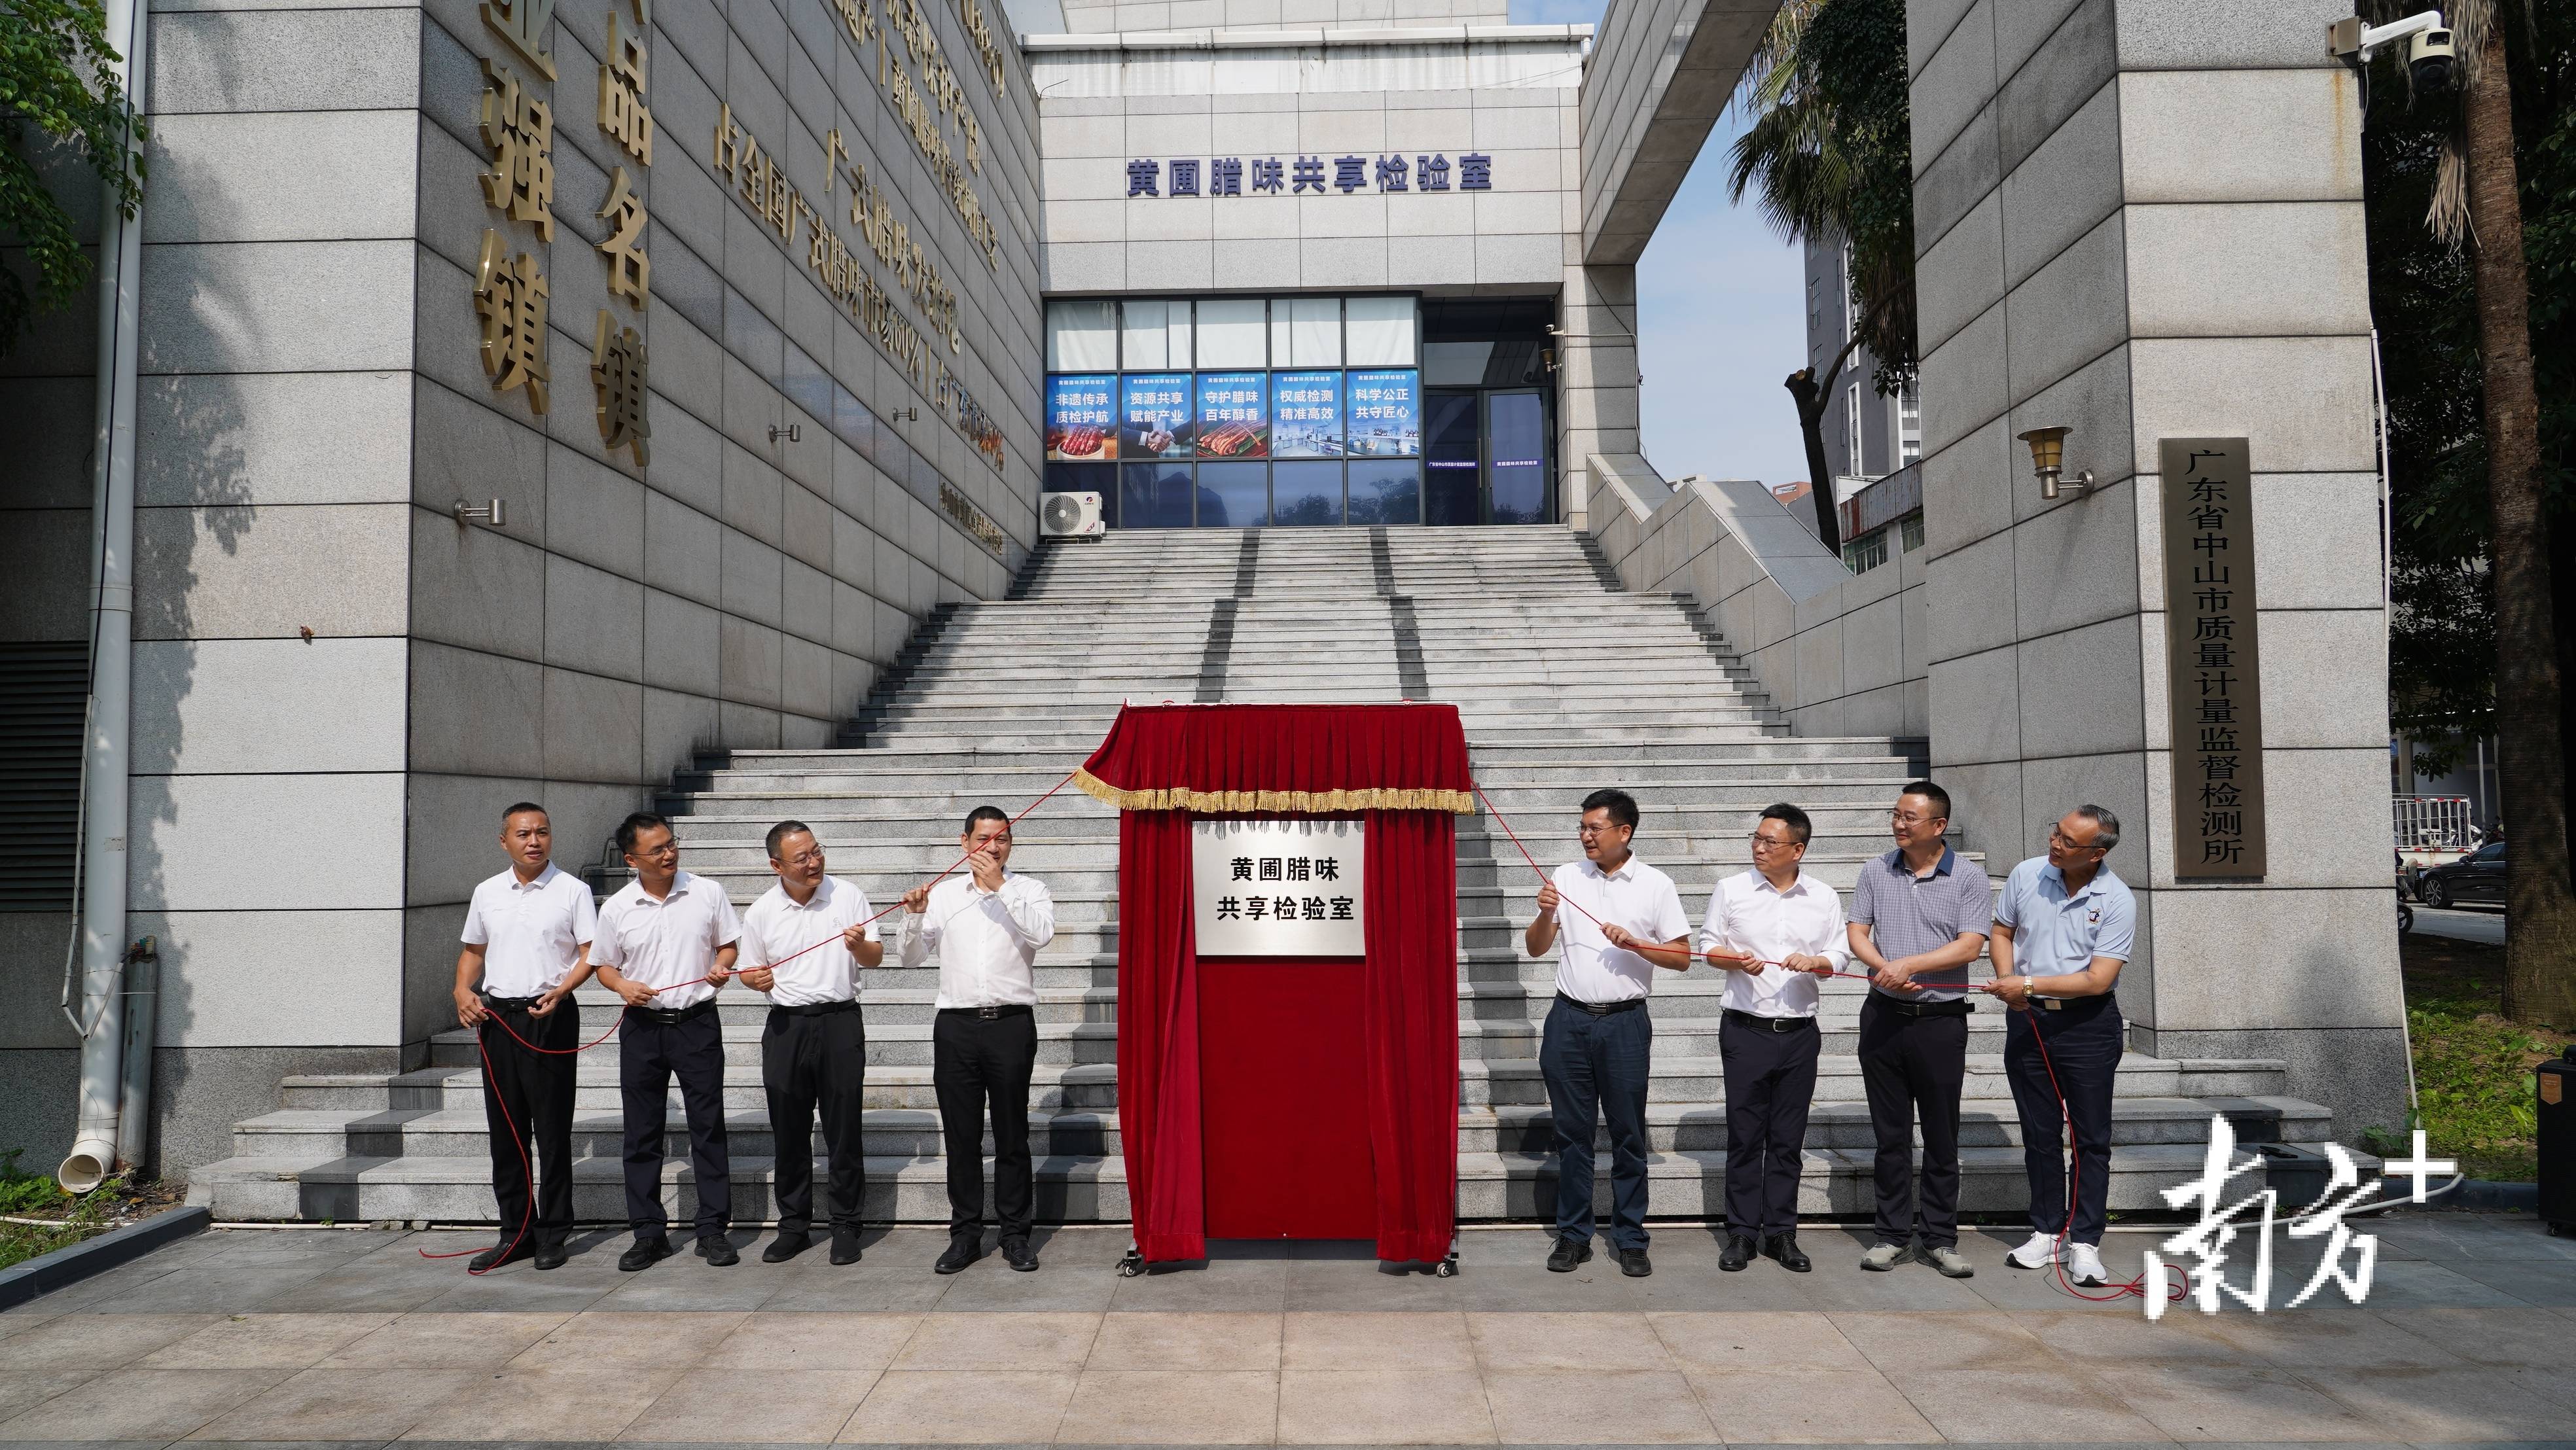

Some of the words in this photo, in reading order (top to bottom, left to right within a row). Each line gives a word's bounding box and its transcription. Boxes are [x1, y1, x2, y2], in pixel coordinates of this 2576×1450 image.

[1126, 154, 1492, 197] 黄圃腊味共享检验室
[591, 0, 653, 467] 品名镇
[825, 128, 960, 355] 广式腊味发源地
[1056, 393, 1109, 406] 非遗传承
[1130, 392, 1183, 405] 资源共享
[1205, 391, 1258, 404] 守护腊味
[1280, 389, 1333, 402] 权威检测
[1355, 388, 1409, 401] 科学公正
[1056, 410, 1109, 423] 质检护航
[1130, 409, 1184, 423] 赋能产业
[1205, 408, 1258, 421] 百年醇香
[1280, 407, 1334, 421] 精准高效
[1355, 406, 1409, 419] 共守匠心
[2184, 450, 2245, 865] 广东省中山市质量计量监督检测所
[1230, 856, 1339, 881] 黄圃腊味
[1217, 895, 1354, 921] 共享检验室
